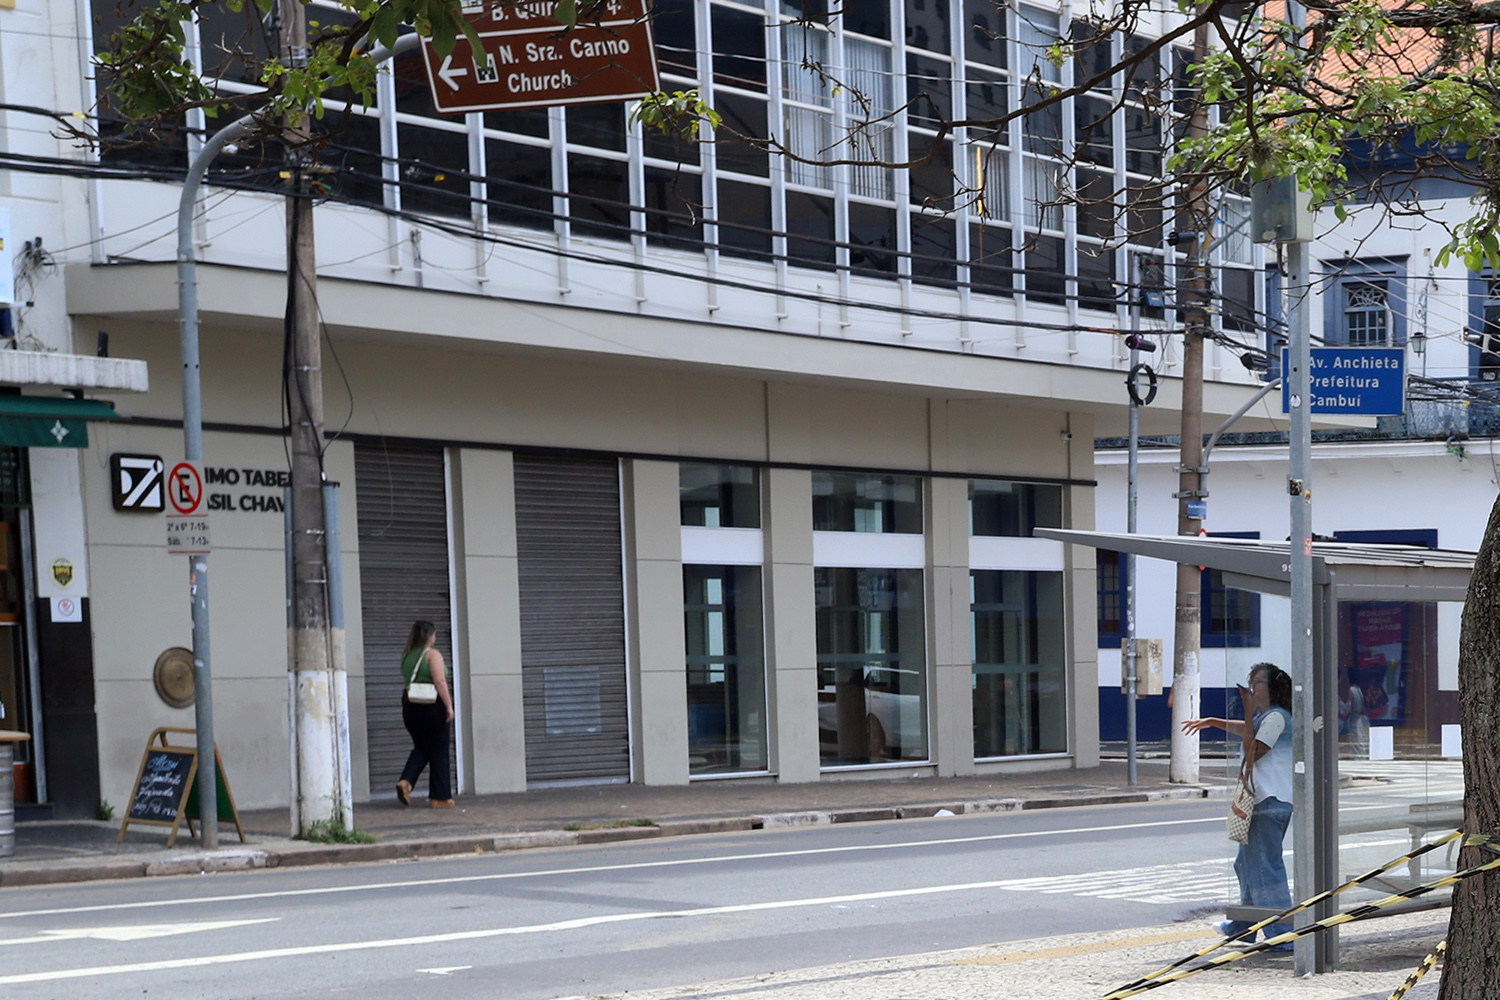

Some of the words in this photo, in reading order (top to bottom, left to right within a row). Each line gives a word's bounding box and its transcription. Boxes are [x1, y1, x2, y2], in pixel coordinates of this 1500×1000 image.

[500, 46, 519, 64] N.
[527, 42, 563, 63] Sra.
[570, 38, 630, 59] Carmo
[508, 69, 573, 94] Church
[1310, 357, 1328, 369] Av.
[1333, 356, 1399, 369] Anchieta
[1310, 375, 1380, 388] Prefeitura
[1310, 393, 1361, 407] Cambuí
[205, 467, 240, 485] IMO
